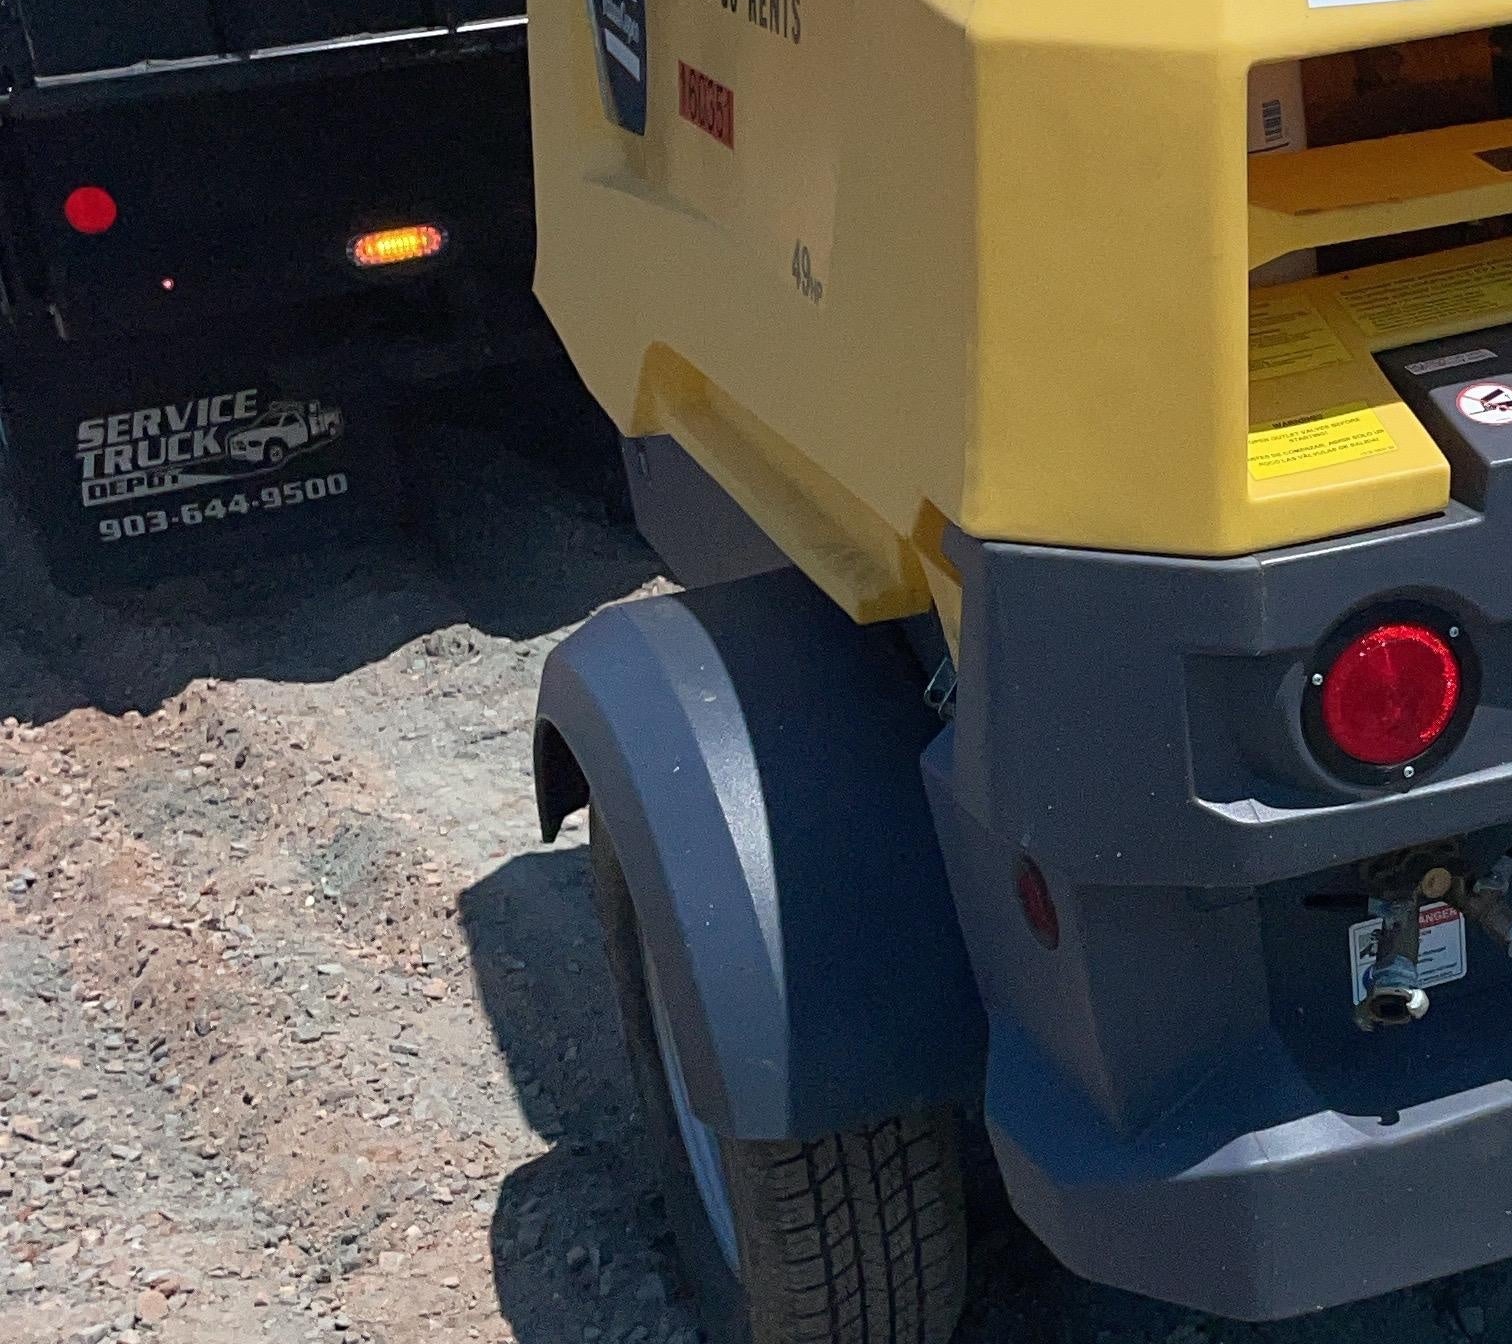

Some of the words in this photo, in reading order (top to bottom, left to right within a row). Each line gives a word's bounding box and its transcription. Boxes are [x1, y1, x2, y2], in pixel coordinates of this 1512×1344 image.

[77, 388, 258, 451] SERVICE
[80, 426, 223, 479] TRUCK
[99, 472, 348, 543] 903-644-9500
[1419, 908, 1458, 924] ANGER
